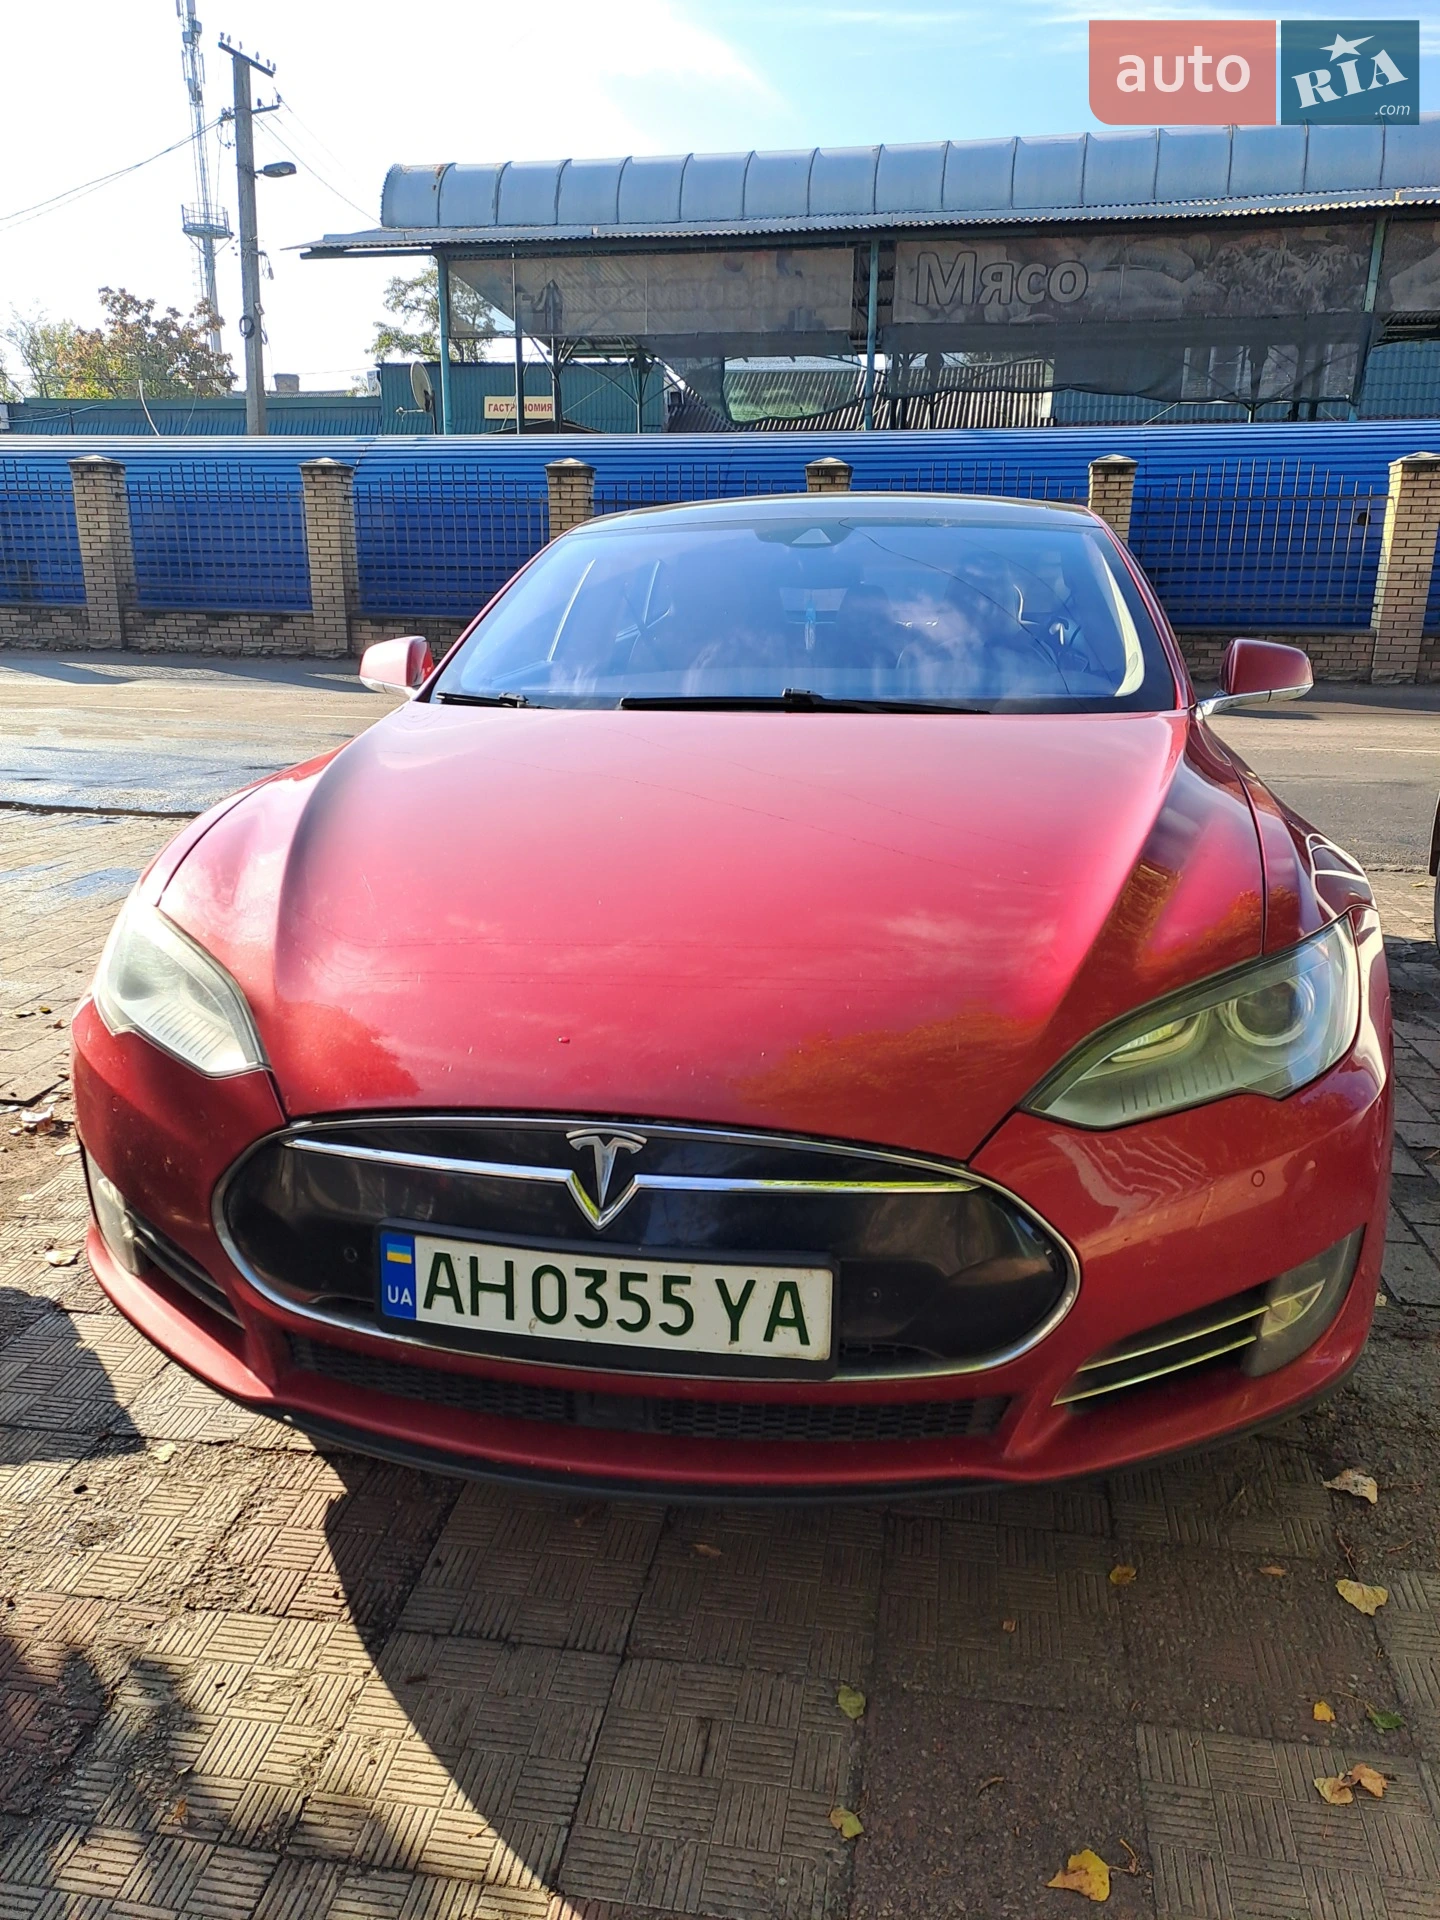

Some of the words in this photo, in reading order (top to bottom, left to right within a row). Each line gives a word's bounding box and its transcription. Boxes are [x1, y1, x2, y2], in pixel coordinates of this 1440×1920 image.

[915, 251, 1089, 305] Мясо
[387, 1284, 413, 1306] UA
[422, 1252, 515, 1321] AH
[531, 1264, 694, 1336] 0355
[715, 1277, 810, 1346] YA
